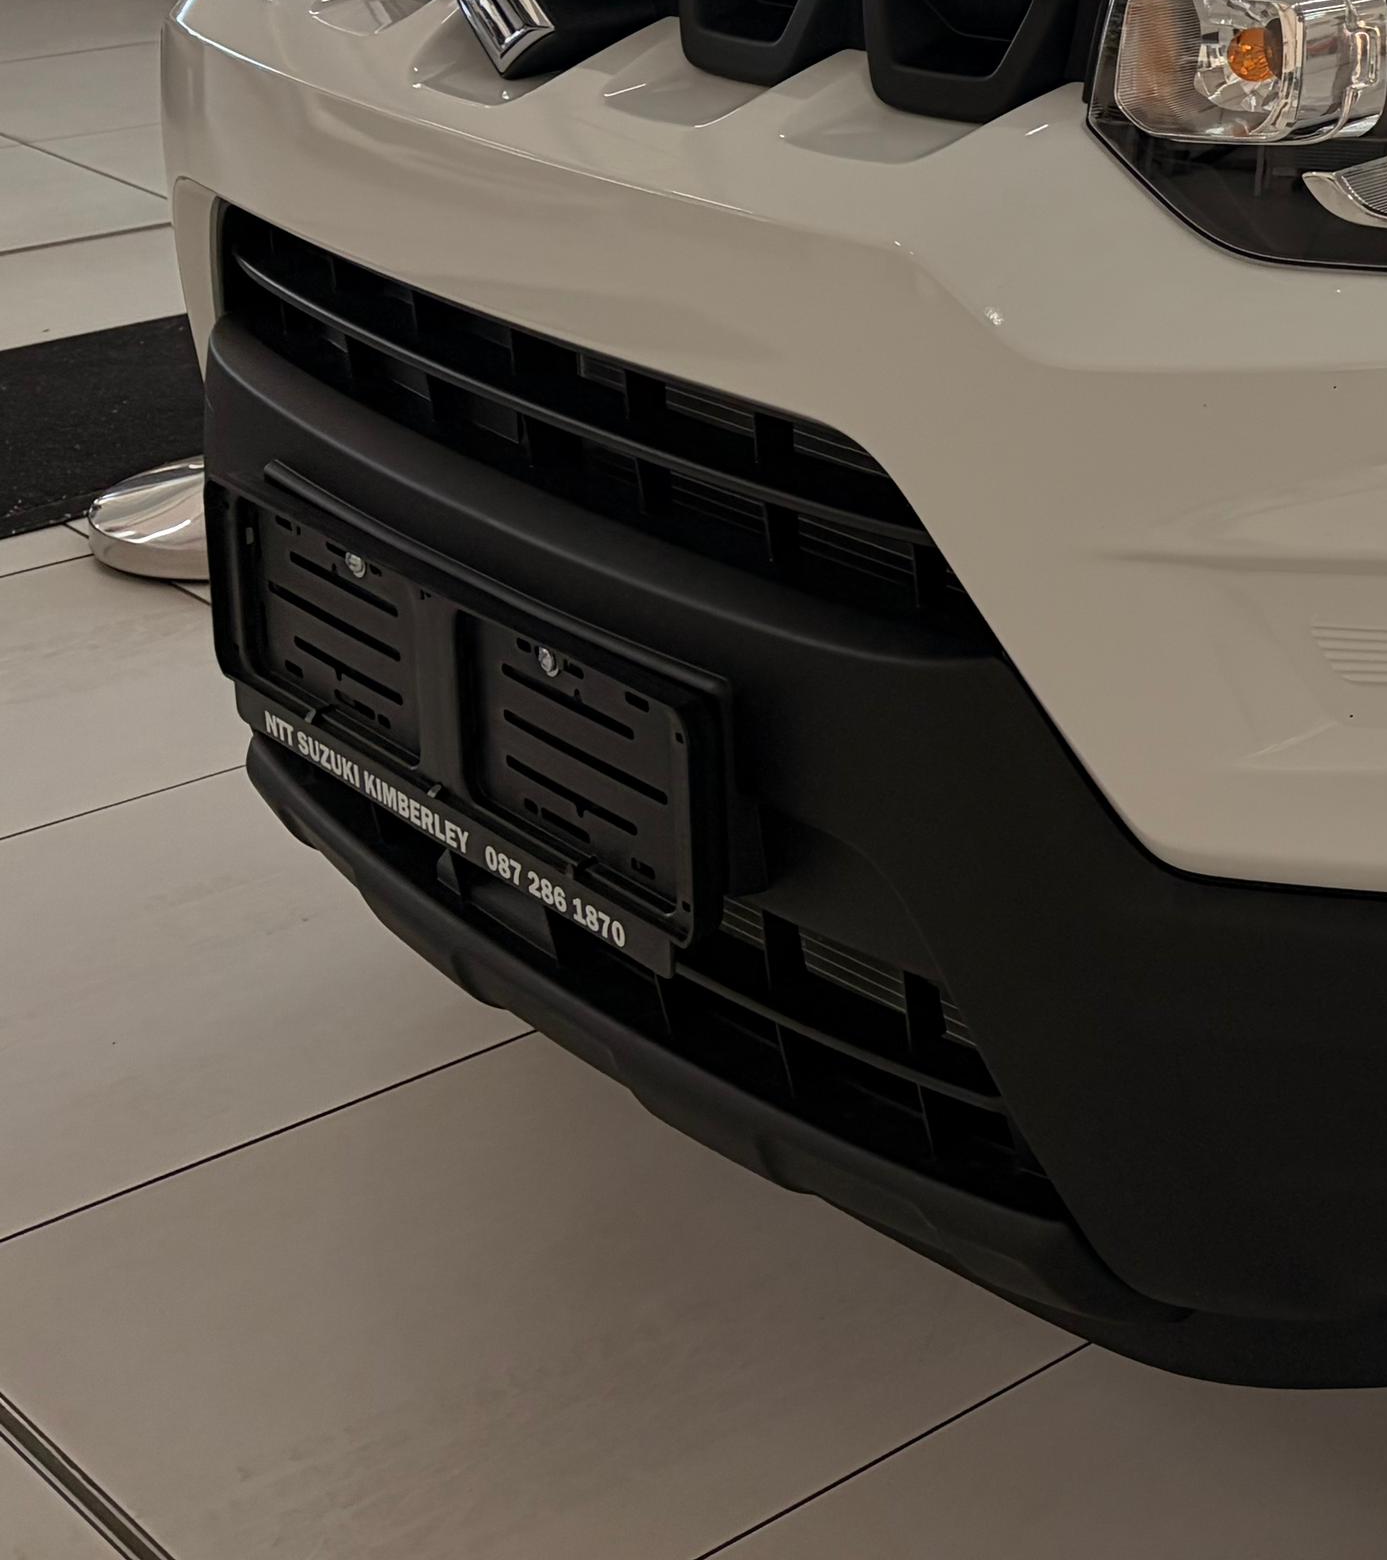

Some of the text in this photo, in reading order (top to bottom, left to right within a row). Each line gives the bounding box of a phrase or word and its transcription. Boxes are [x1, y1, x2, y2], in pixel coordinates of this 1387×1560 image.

[264, 710, 626, 948] NTT SUZUKI KIMBERLEY 087 286 1870
